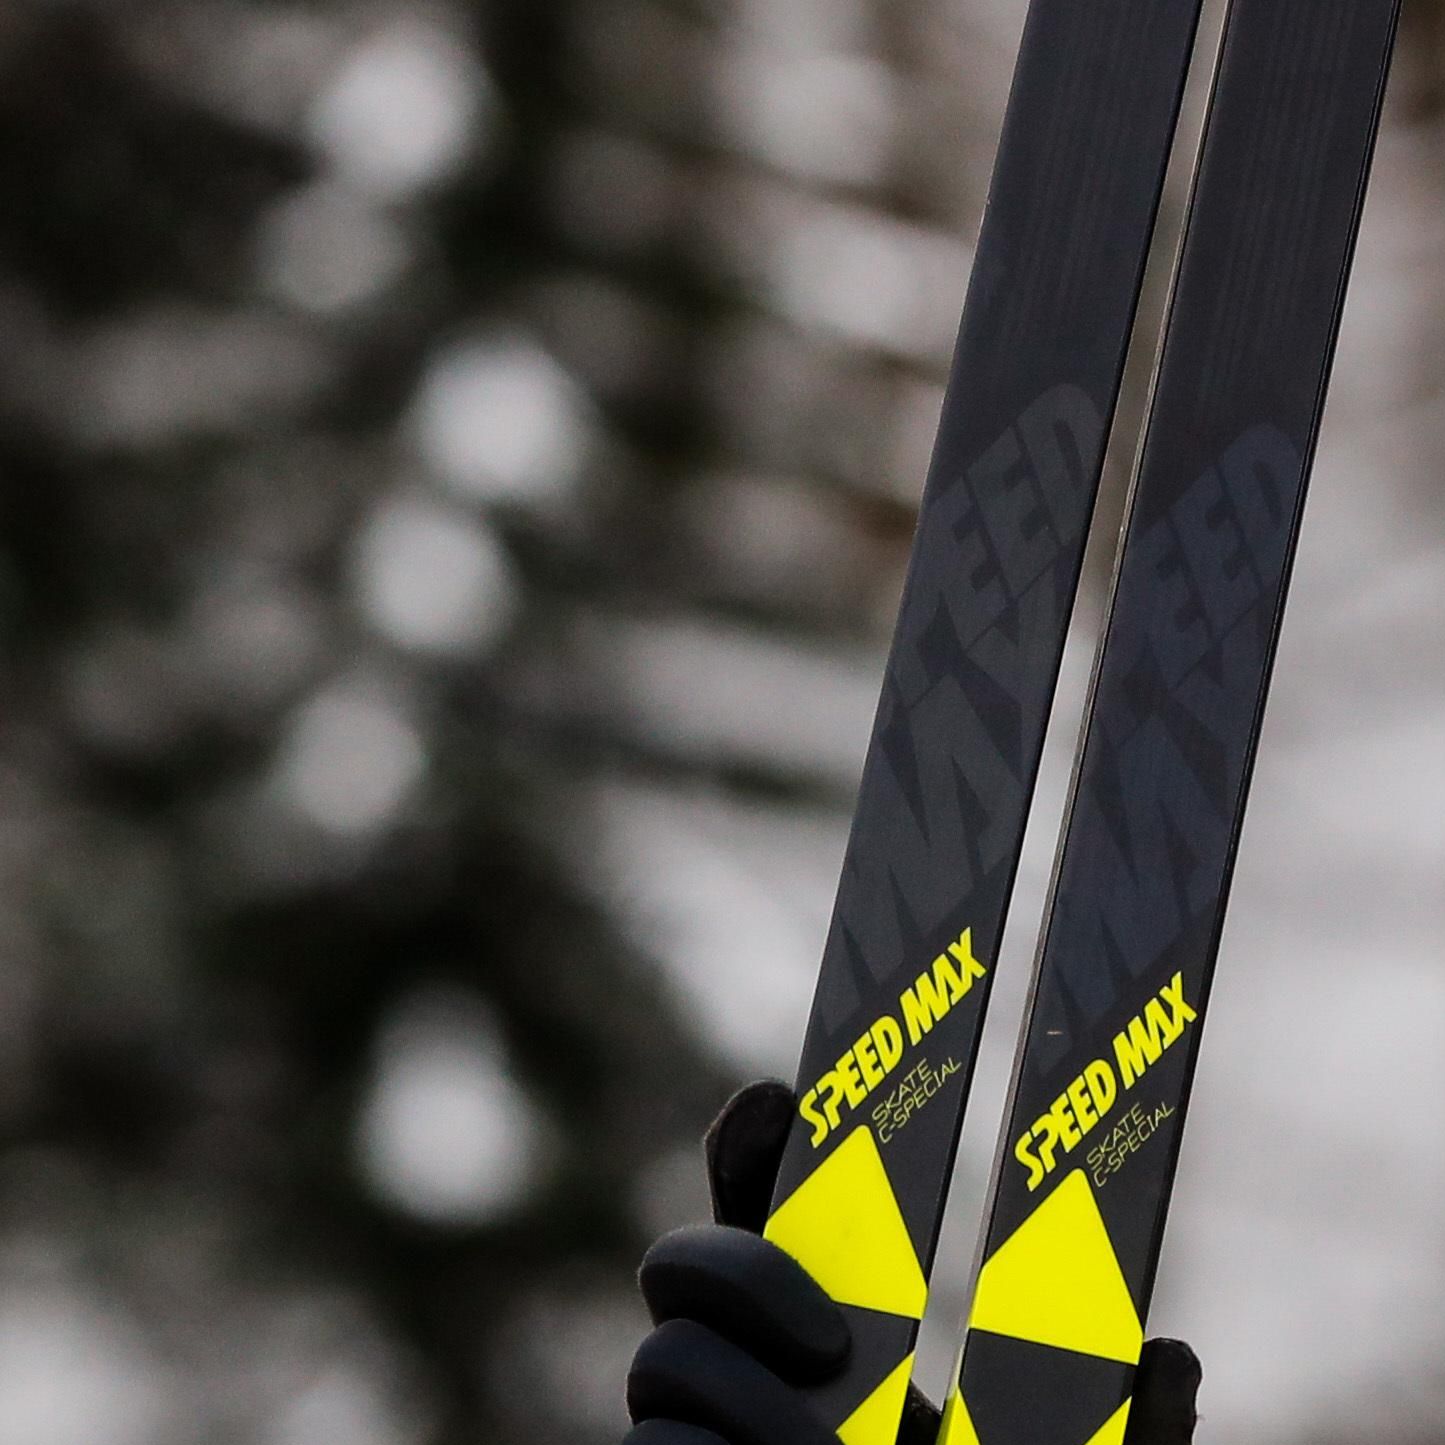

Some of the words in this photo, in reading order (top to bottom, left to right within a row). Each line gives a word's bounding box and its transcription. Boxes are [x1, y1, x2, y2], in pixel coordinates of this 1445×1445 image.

[799, 1015, 904, 1149] SPEED
[899, 926, 987, 1047] MAX
[1014, 1058, 1118, 1192] SPEED
[1111, 970, 1198, 1091] MAX
[871, 1056, 933, 1126] SKATE
[877, 1056, 962, 1144] C-SPECIAL
[1086, 1102, 1145, 1171] SKATE
[1091, 1102, 1175, 1189] C-SPECIAL
